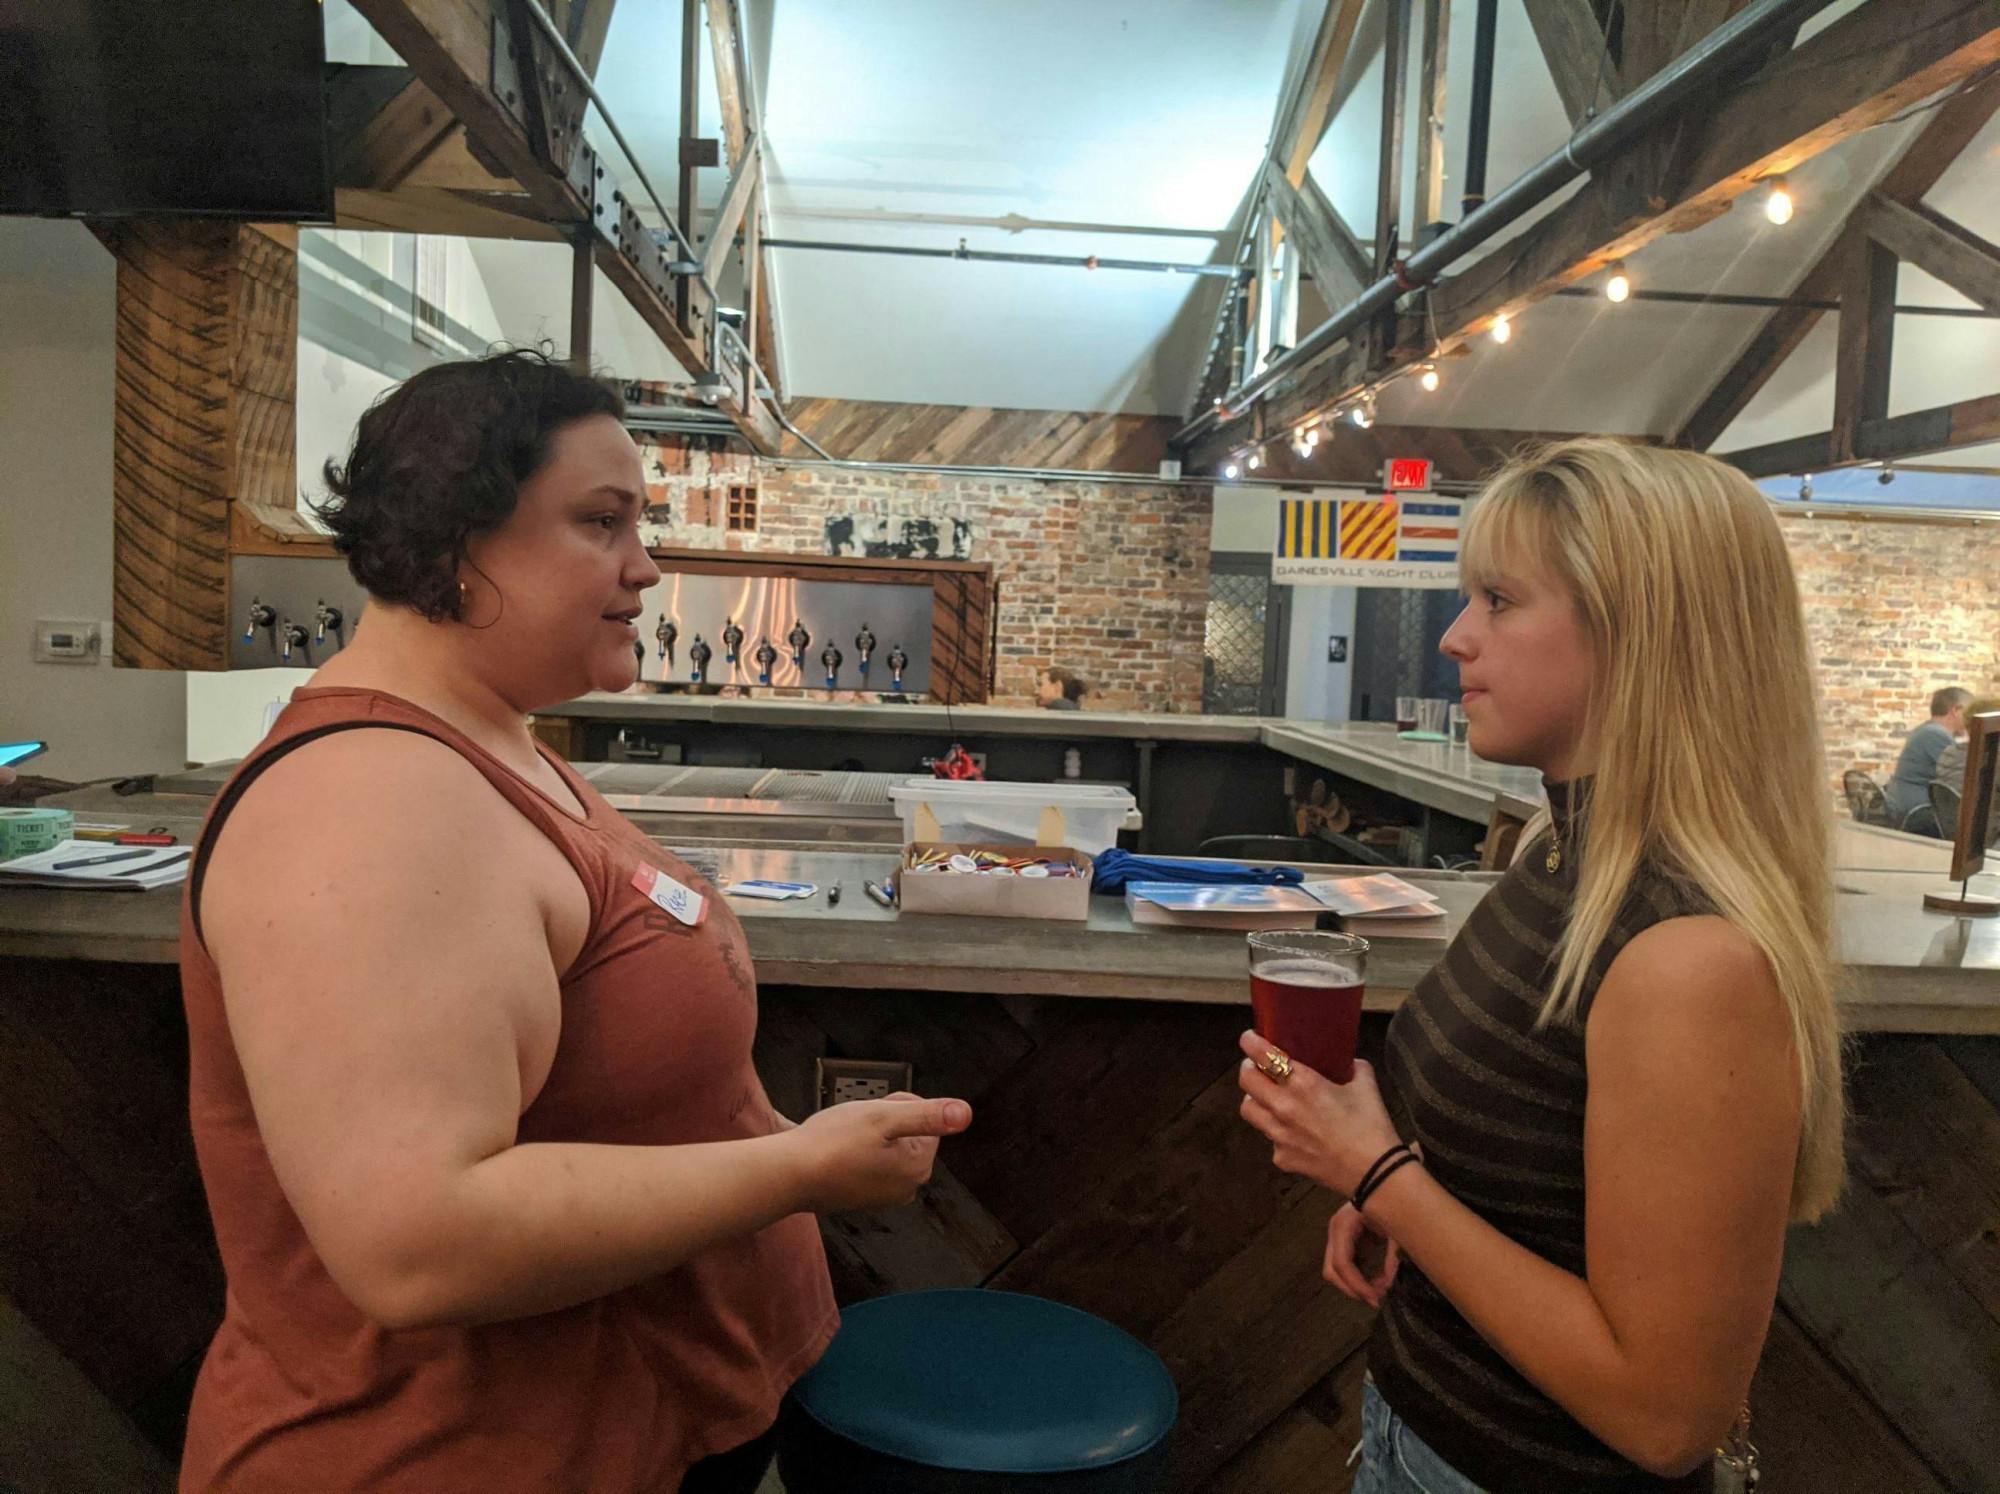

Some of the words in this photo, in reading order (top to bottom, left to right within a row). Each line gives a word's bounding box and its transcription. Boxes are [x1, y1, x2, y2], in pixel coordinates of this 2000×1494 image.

[1276, 565, 1364, 577] GAINESVILLE
[1368, 567, 1413, 578] YACHT
[16, 823, 44, 833] TICKET
